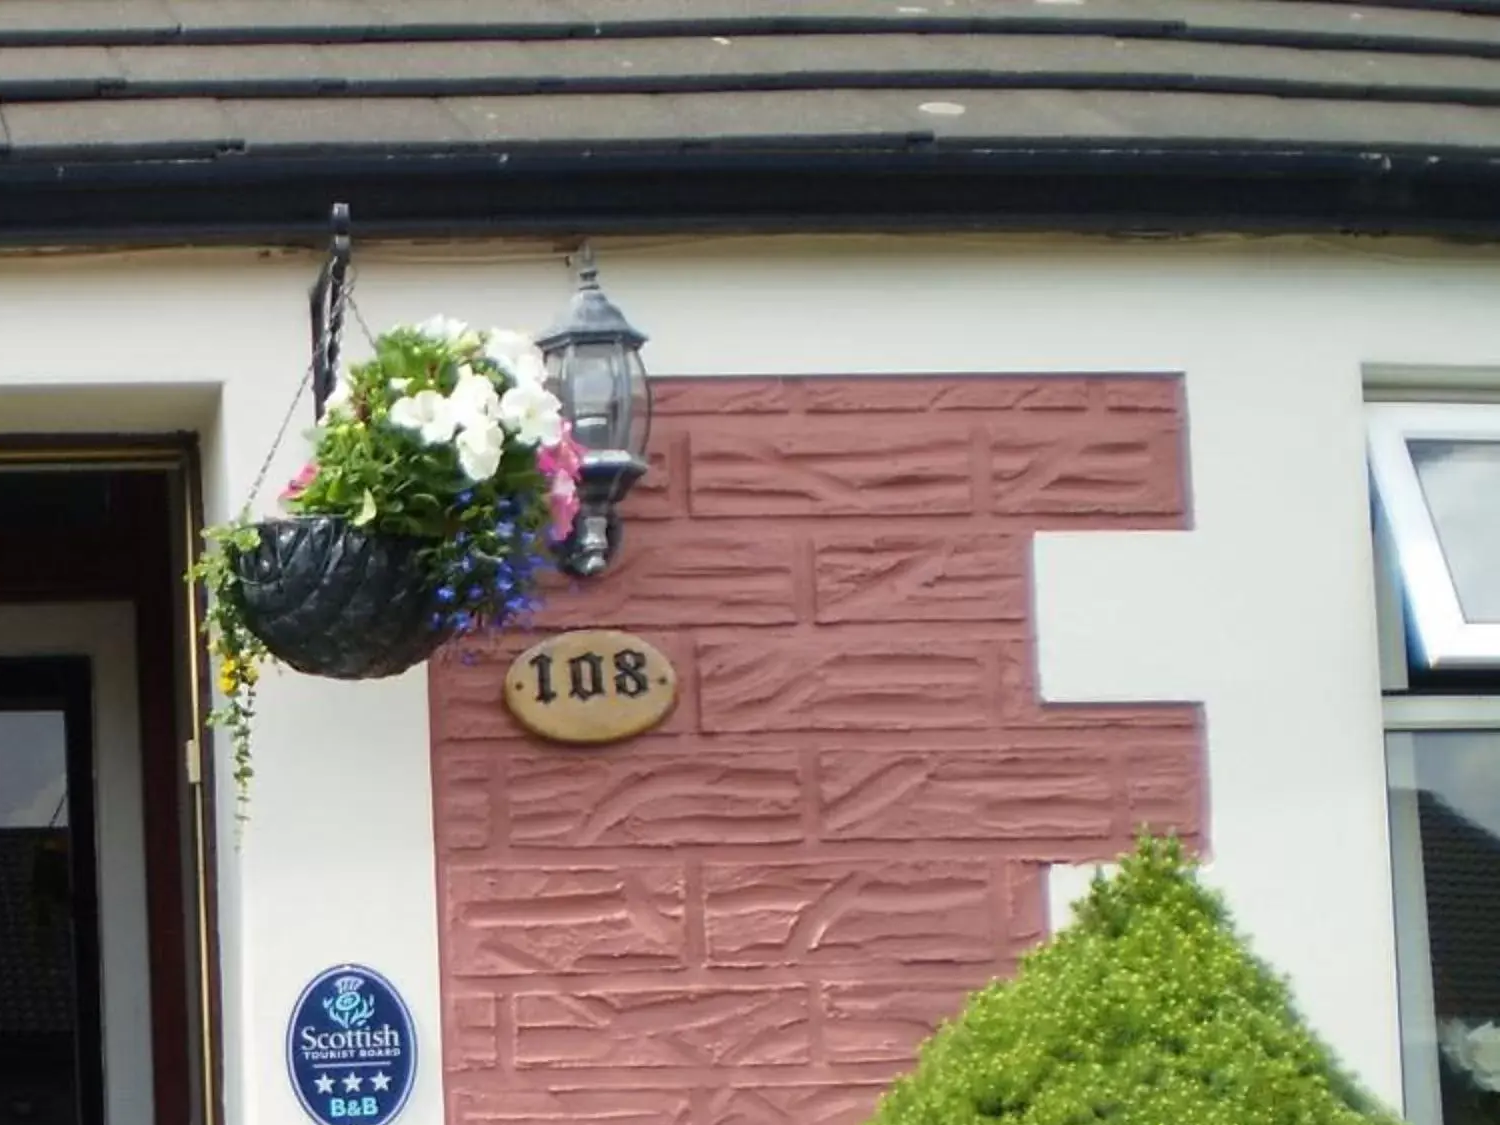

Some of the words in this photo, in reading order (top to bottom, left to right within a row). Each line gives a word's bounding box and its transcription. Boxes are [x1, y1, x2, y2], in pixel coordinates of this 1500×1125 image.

[529, 649, 648, 704] 108
[301, 1024, 400, 1051] Scottish
[303, 1050, 355, 1060] TOURIST
[359, 1048, 401, 1057] BOARD
[330, 1097, 378, 1117] B&B
